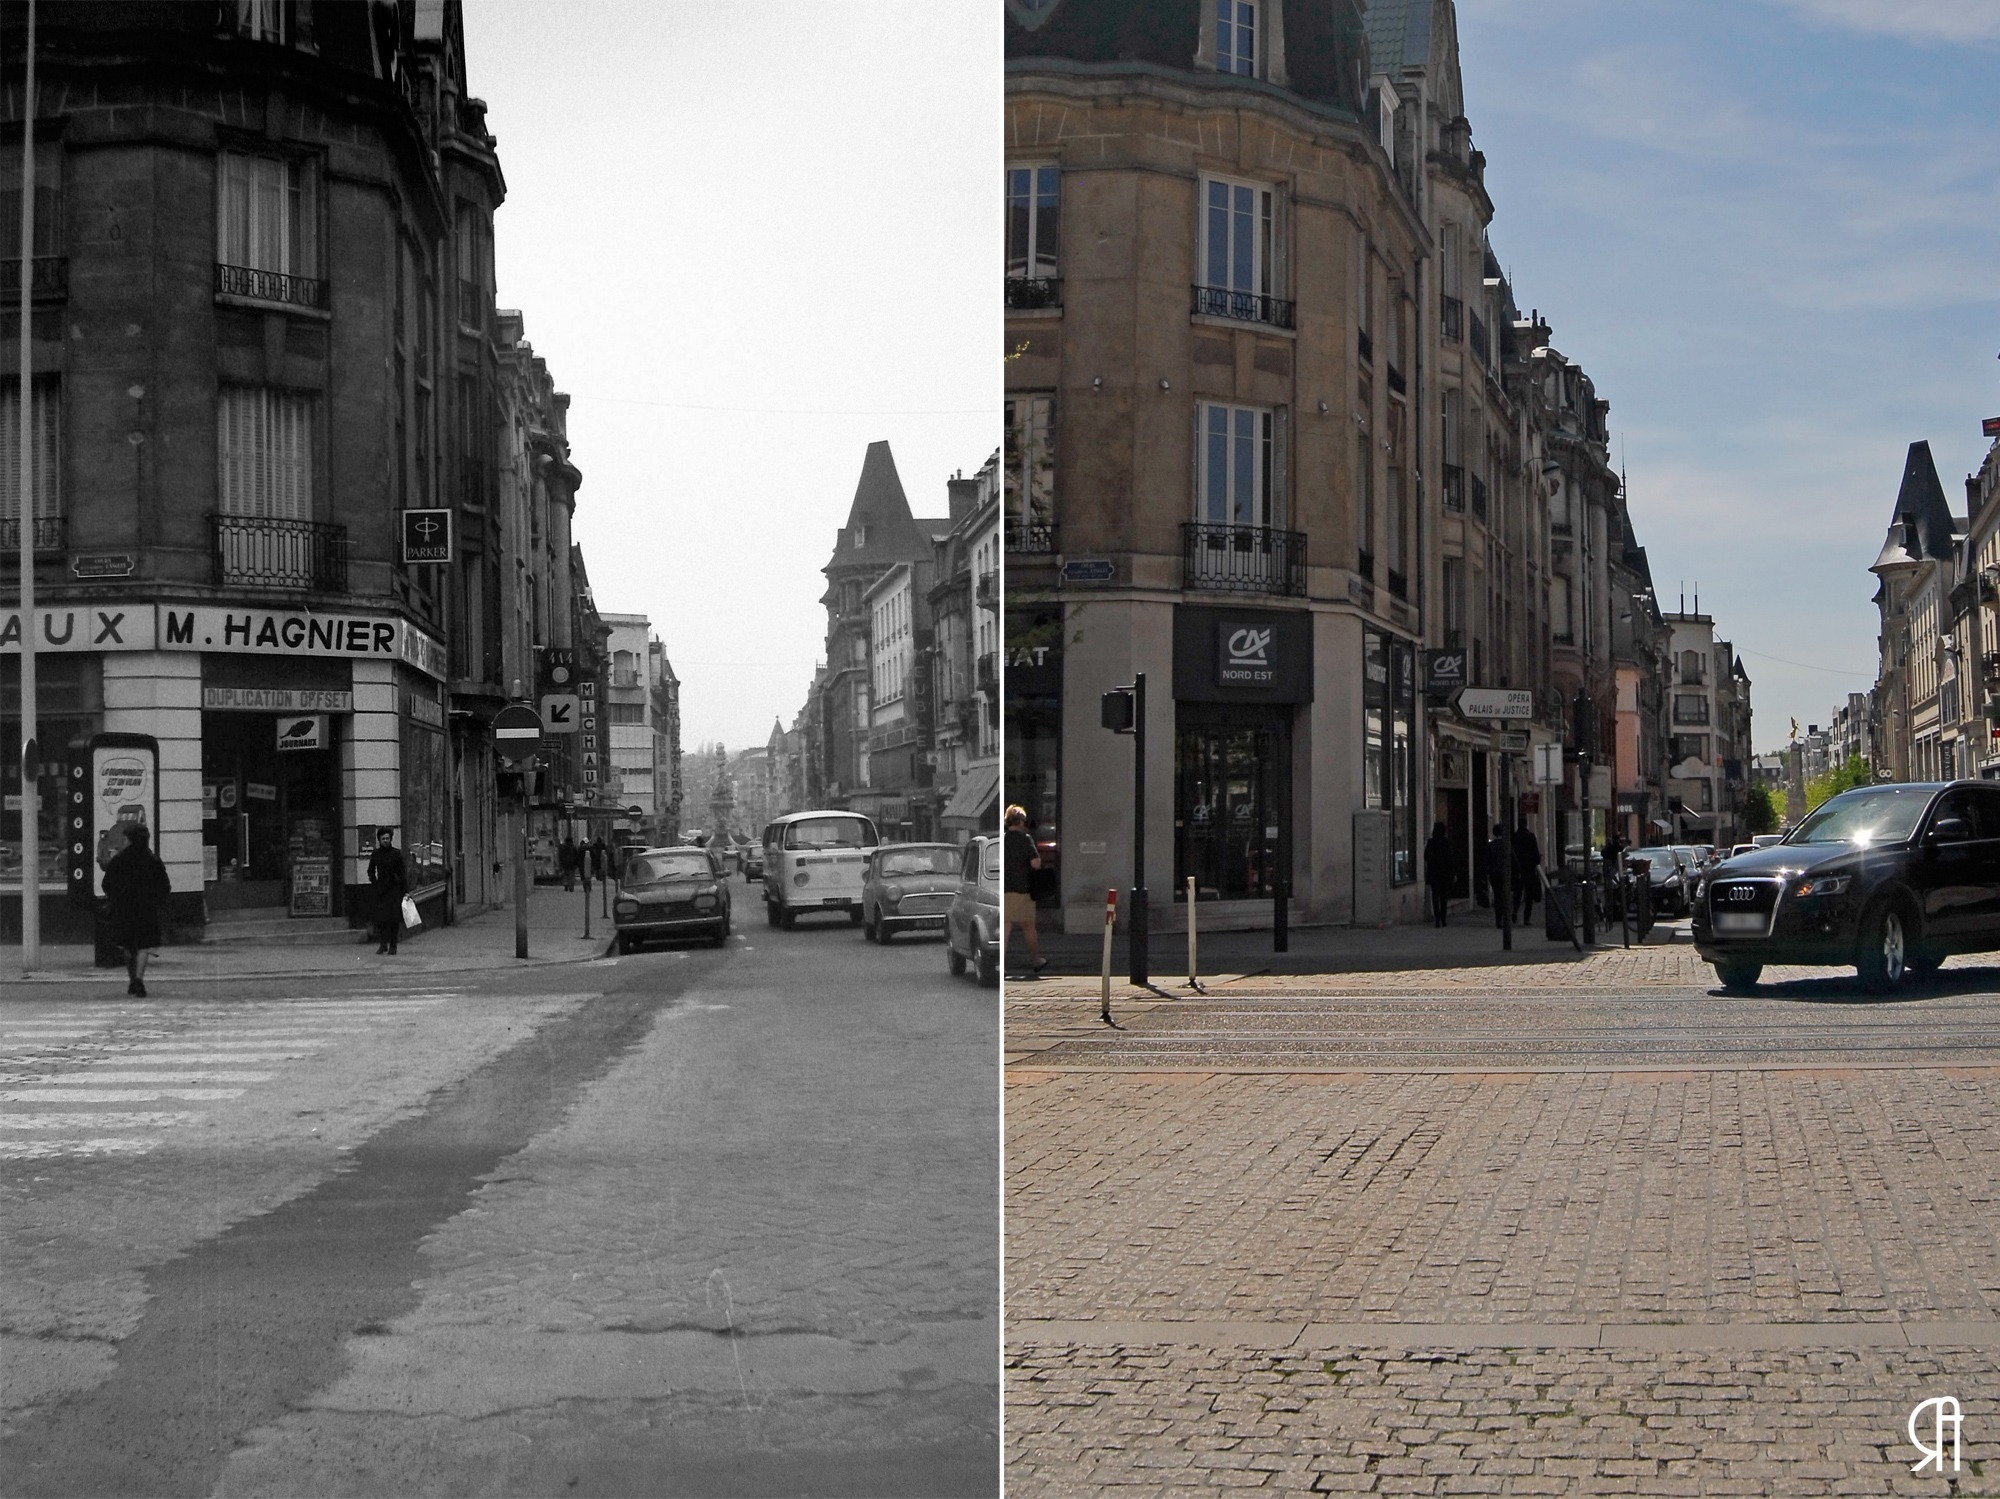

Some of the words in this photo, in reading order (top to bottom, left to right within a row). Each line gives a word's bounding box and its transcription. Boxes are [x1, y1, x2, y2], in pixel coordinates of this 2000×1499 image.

[407, 547, 447, 558] PARKER
[224, 614, 395, 653] HAGNIER
[1222, 670, 1252, 680] NORD
[1254, 670, 1273, 680] EST
[207, 689, 293, 707] DUPLICATION
[300, 691, 349, 708] OFFSET
[1507, 692, 1530, 703] OPÉRA
[1468, 704, 1493, 714] PALAIS
[1502, 704, 1530, 715] JUSTICE
[279, 738, 318, 749] JOURNAUX
[1879, 769, 1892, 778] GO
